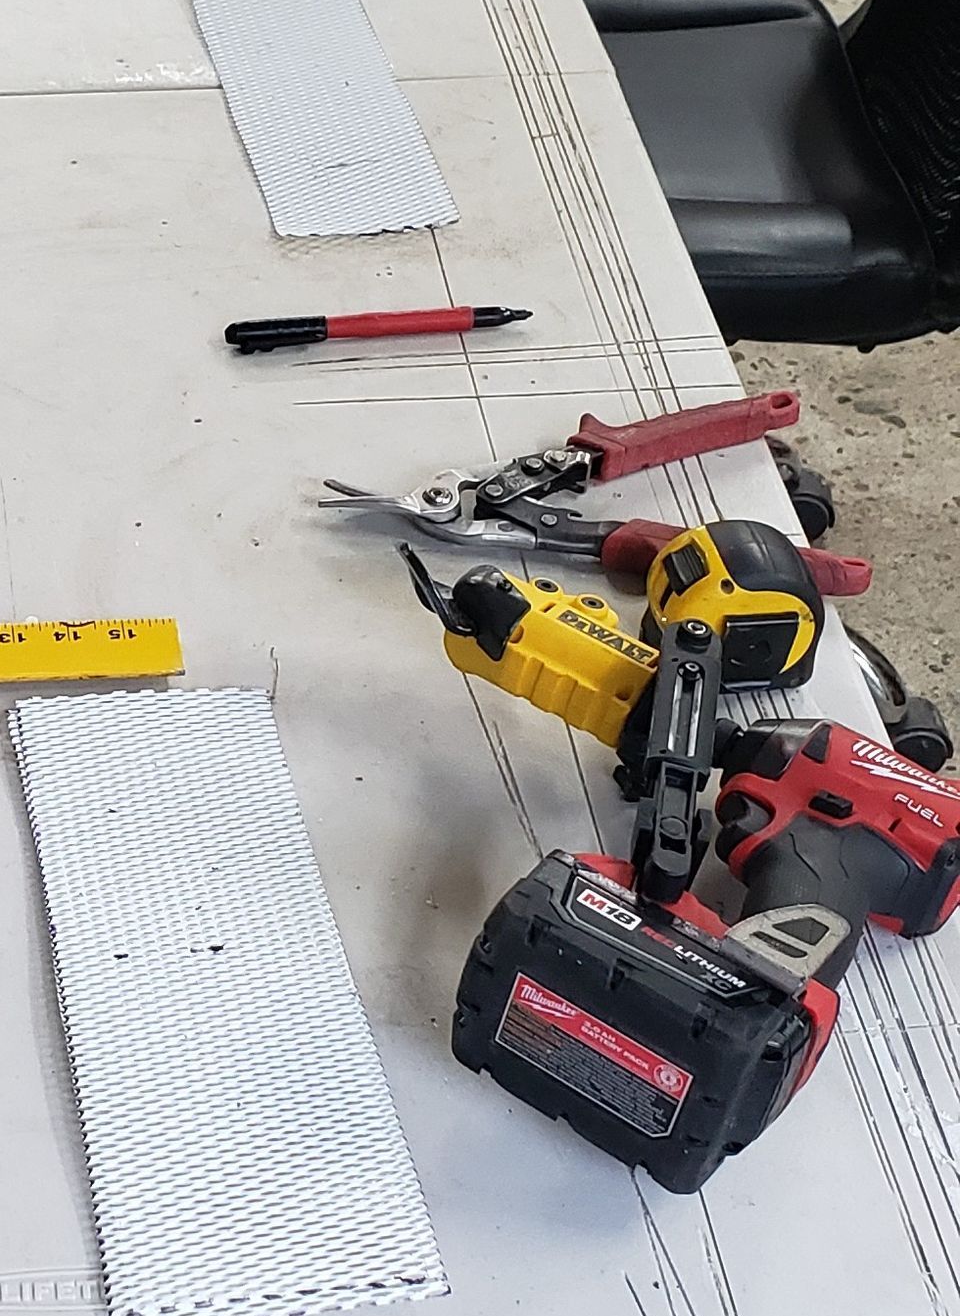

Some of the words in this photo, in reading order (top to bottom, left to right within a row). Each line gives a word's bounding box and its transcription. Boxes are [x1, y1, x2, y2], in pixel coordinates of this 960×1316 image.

[0, 632, 27, 644] 13
[53, 630, 81, 642] 14
[108, 628, 137, 640] 15
[894, 793, 944, 828] FUEL
[582, 894, 636, 926] M18
[699, 972, 732, 991] XC
[520, 984, 578, 1016] Milwaukee
[581, 1026, 622, 1053] BATTERY
[623, 1049, 650, 1070] PACK
